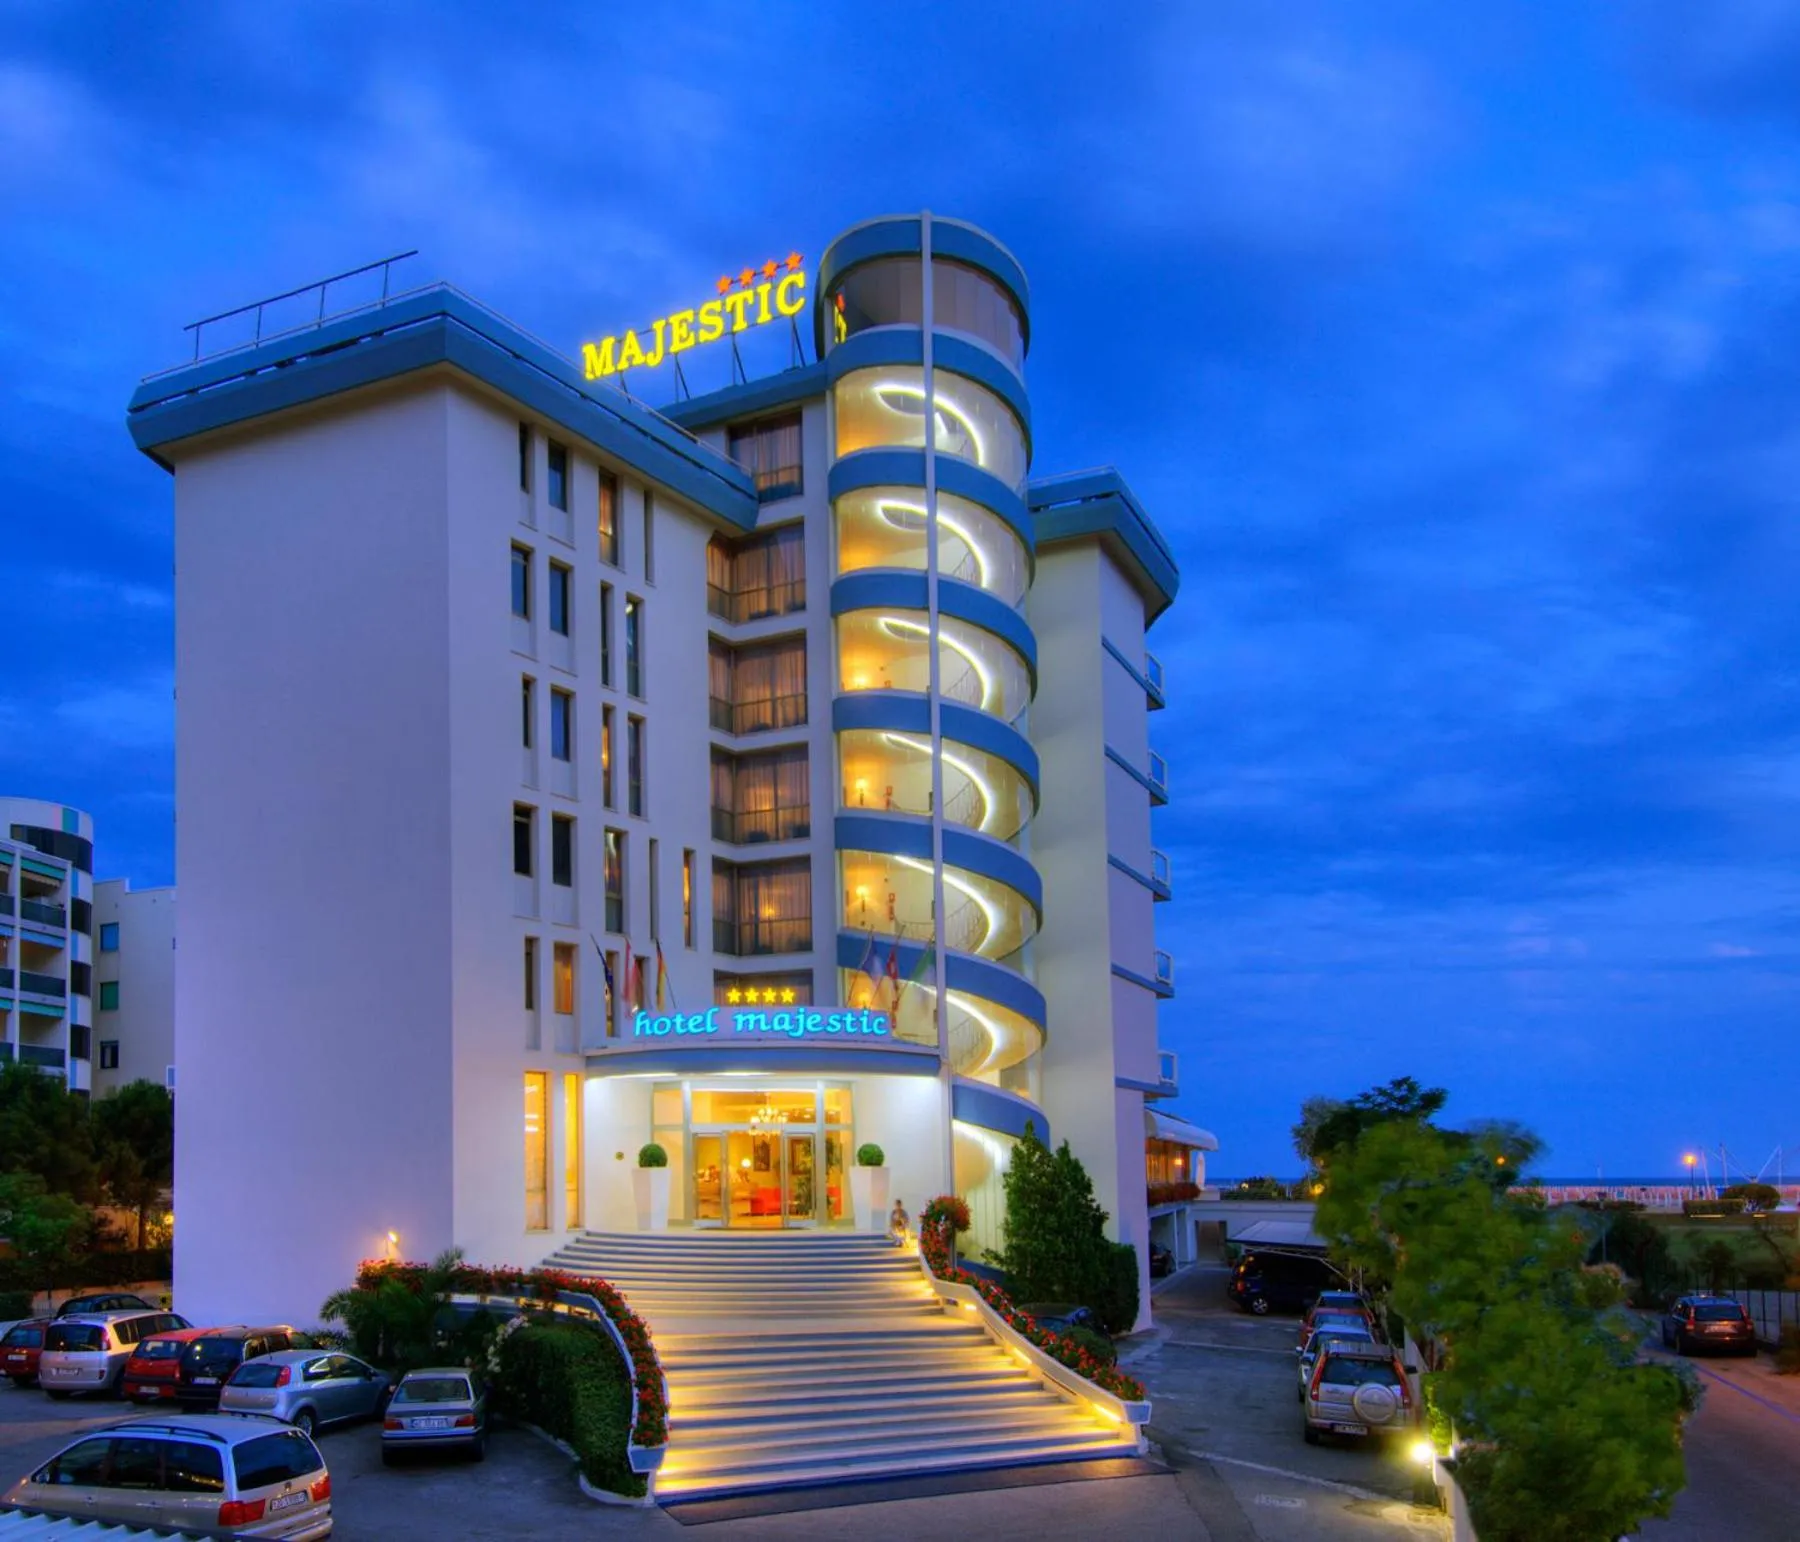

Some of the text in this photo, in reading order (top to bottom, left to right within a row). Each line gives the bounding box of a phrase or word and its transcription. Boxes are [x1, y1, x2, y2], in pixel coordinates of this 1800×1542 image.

[582, 271, 806, 381] MAJESTIC
[634, 1007, 888, 1038] hotel majestic
